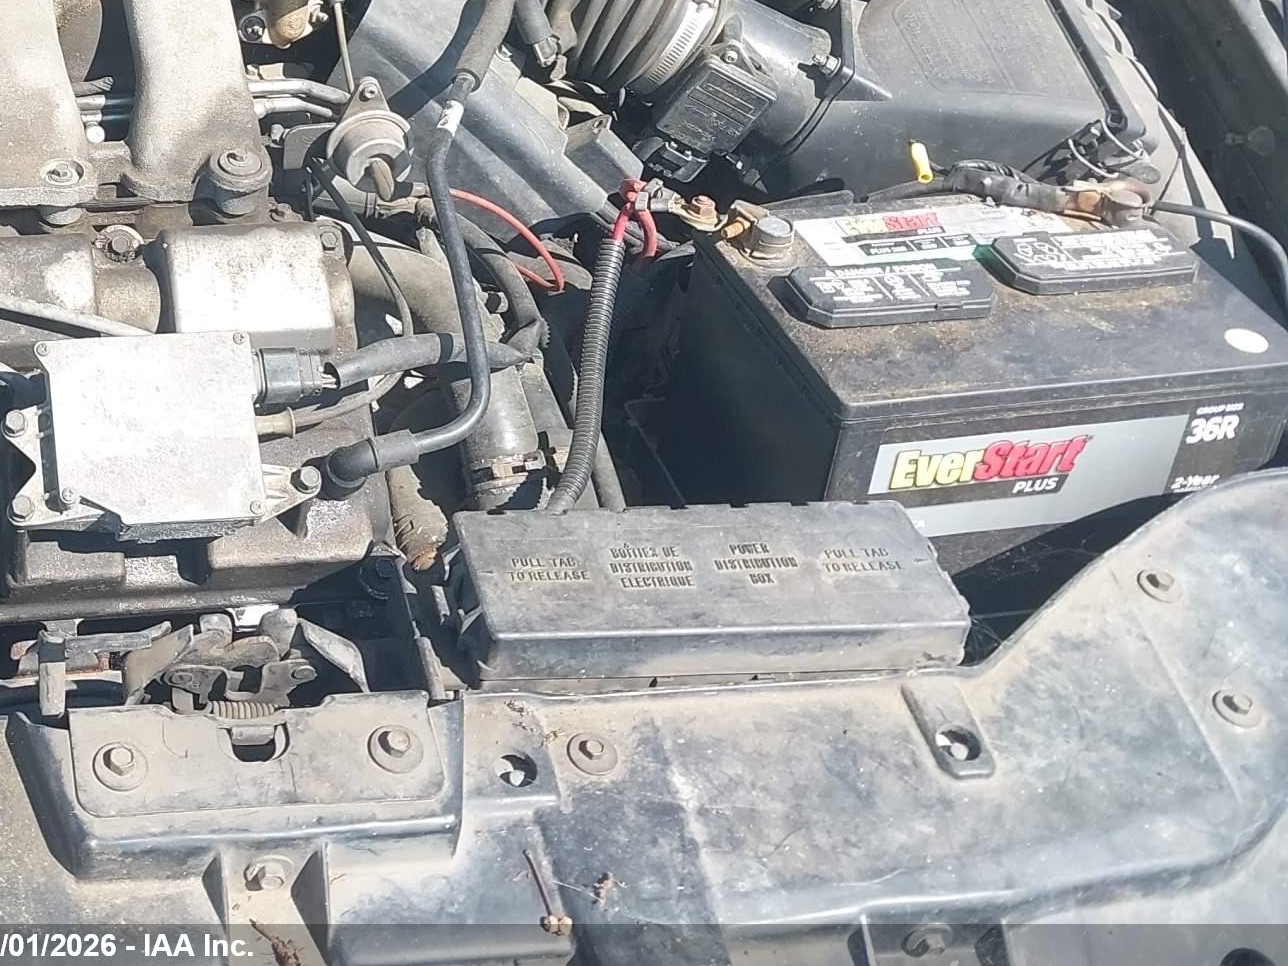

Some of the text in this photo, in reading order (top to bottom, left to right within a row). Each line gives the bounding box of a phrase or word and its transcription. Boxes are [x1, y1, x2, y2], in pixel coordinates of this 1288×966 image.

[1186, 414, 1240, 444] 36R
[888, 434, 1089, 491] EverStart
[1012, 477, 1059, 494] PLUS
[1171, 474, 1220, 489] 2-Year
[661, 545, 679, 558] DE
[729, 543, 770, 556] POWER
[823, 546, 890, 560] PULL TAB
[512, 556, 577, 568] PULL TAB
[609, 560, 694, 574] DISTRIBUTION
[714, 556, 799, 571] DISTRIBUTION
[822, 560, 905, 574] TO RELEASE
[508, 570, 591, 582] TO RELEASE
[620, 575, 695, 589] ELECTRIQUE
[748, 573, 775, 585] BOX
